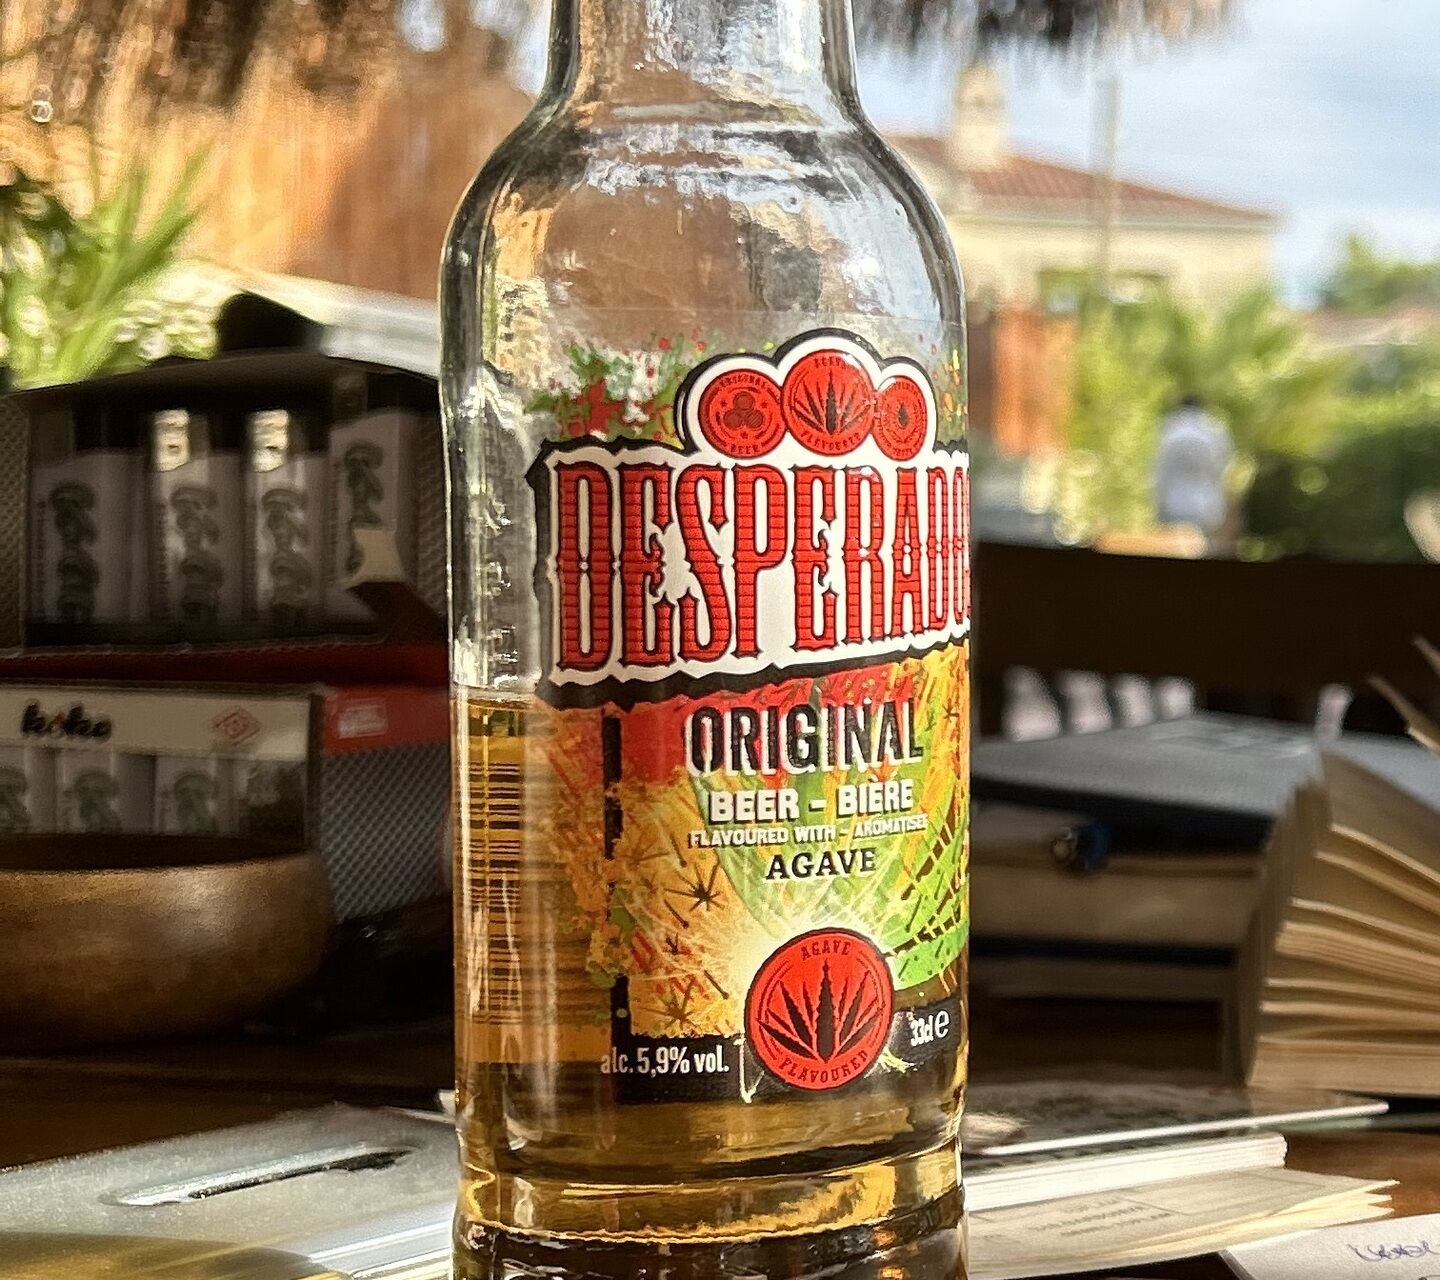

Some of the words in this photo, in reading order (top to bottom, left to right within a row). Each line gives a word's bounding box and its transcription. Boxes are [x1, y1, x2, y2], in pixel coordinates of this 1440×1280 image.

[555, 462, 971, 671] DESPERADO
[686, 699, 924, 777] ORIGINAL
[709, 788, 800, 823] BEER
[837, 776, 914, 817] BIÈRE
[688, 826, 789, 849] FLAVOURED
[794, 824, 836, 843] WITH
[765, 847, 877, 880] AGAVE
[801, 940, 851, 961] AGAVE
[600, 1045, 634, 1074] alc.
[636, 1045, 691, 1078] 5,9%
[693, 1044, 730, 1073] vol.
[778, 1049, 870, 1084] FLAVOURED
